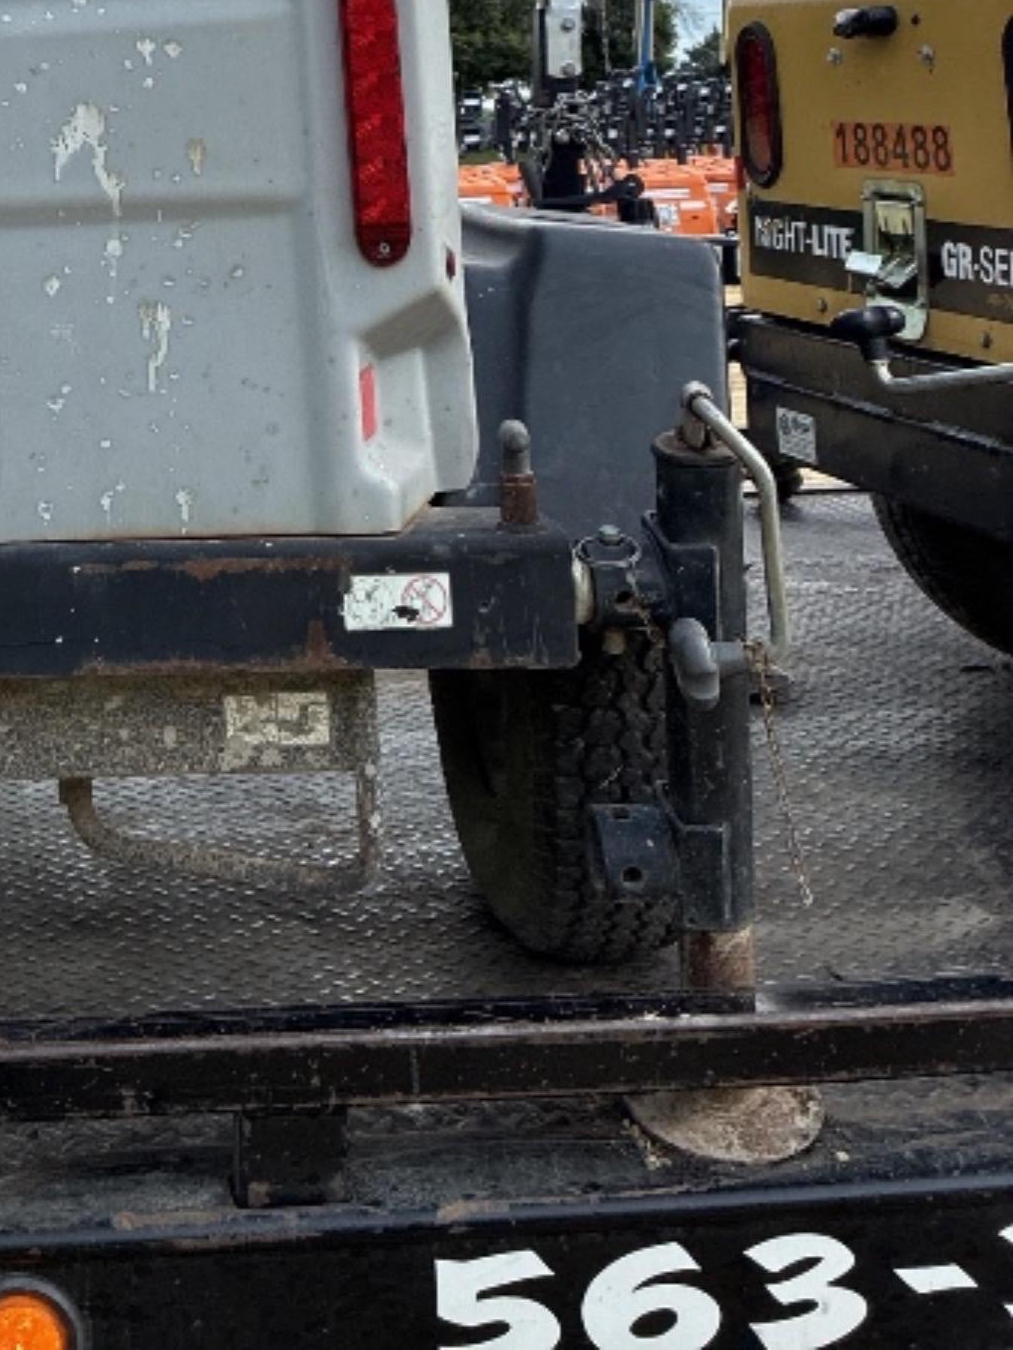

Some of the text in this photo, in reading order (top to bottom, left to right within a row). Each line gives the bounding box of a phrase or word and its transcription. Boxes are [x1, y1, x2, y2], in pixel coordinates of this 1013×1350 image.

[834, 121, 952, 172] 188488
[754, 214, 856, 259] NIGHT-LITE
[941, 240, 1013, 287] GR-SE
[434, 1226, 1013, 1350] 563-
